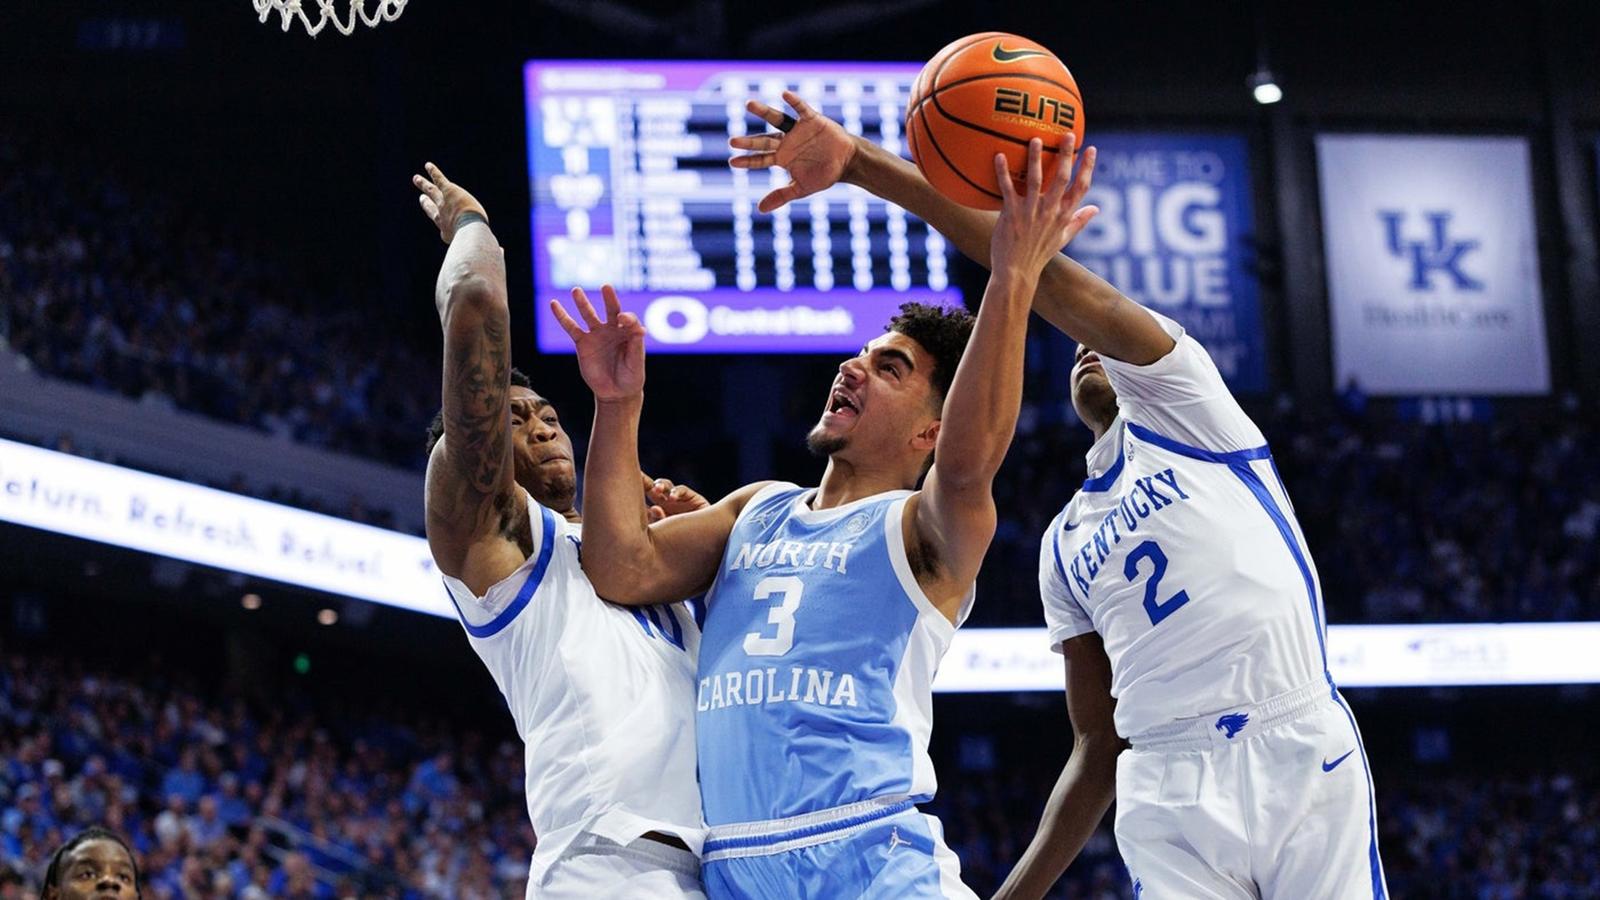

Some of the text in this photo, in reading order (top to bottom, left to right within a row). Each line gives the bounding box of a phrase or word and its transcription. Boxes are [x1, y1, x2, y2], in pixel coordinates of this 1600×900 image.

[993, 87, 1076, 130] ELITE
[1074, 182, 1227, 255] BIG
[1377, 210, 1486, 291] UK
[729, 539, 853, 575] NORTH
[1070, 468, 1190, 599] KENTUCKY
[742, 575, 805, 657] 3
[1123, 540, 1191, 627] 2
[697, 667, 858, 712] CAROLINA
